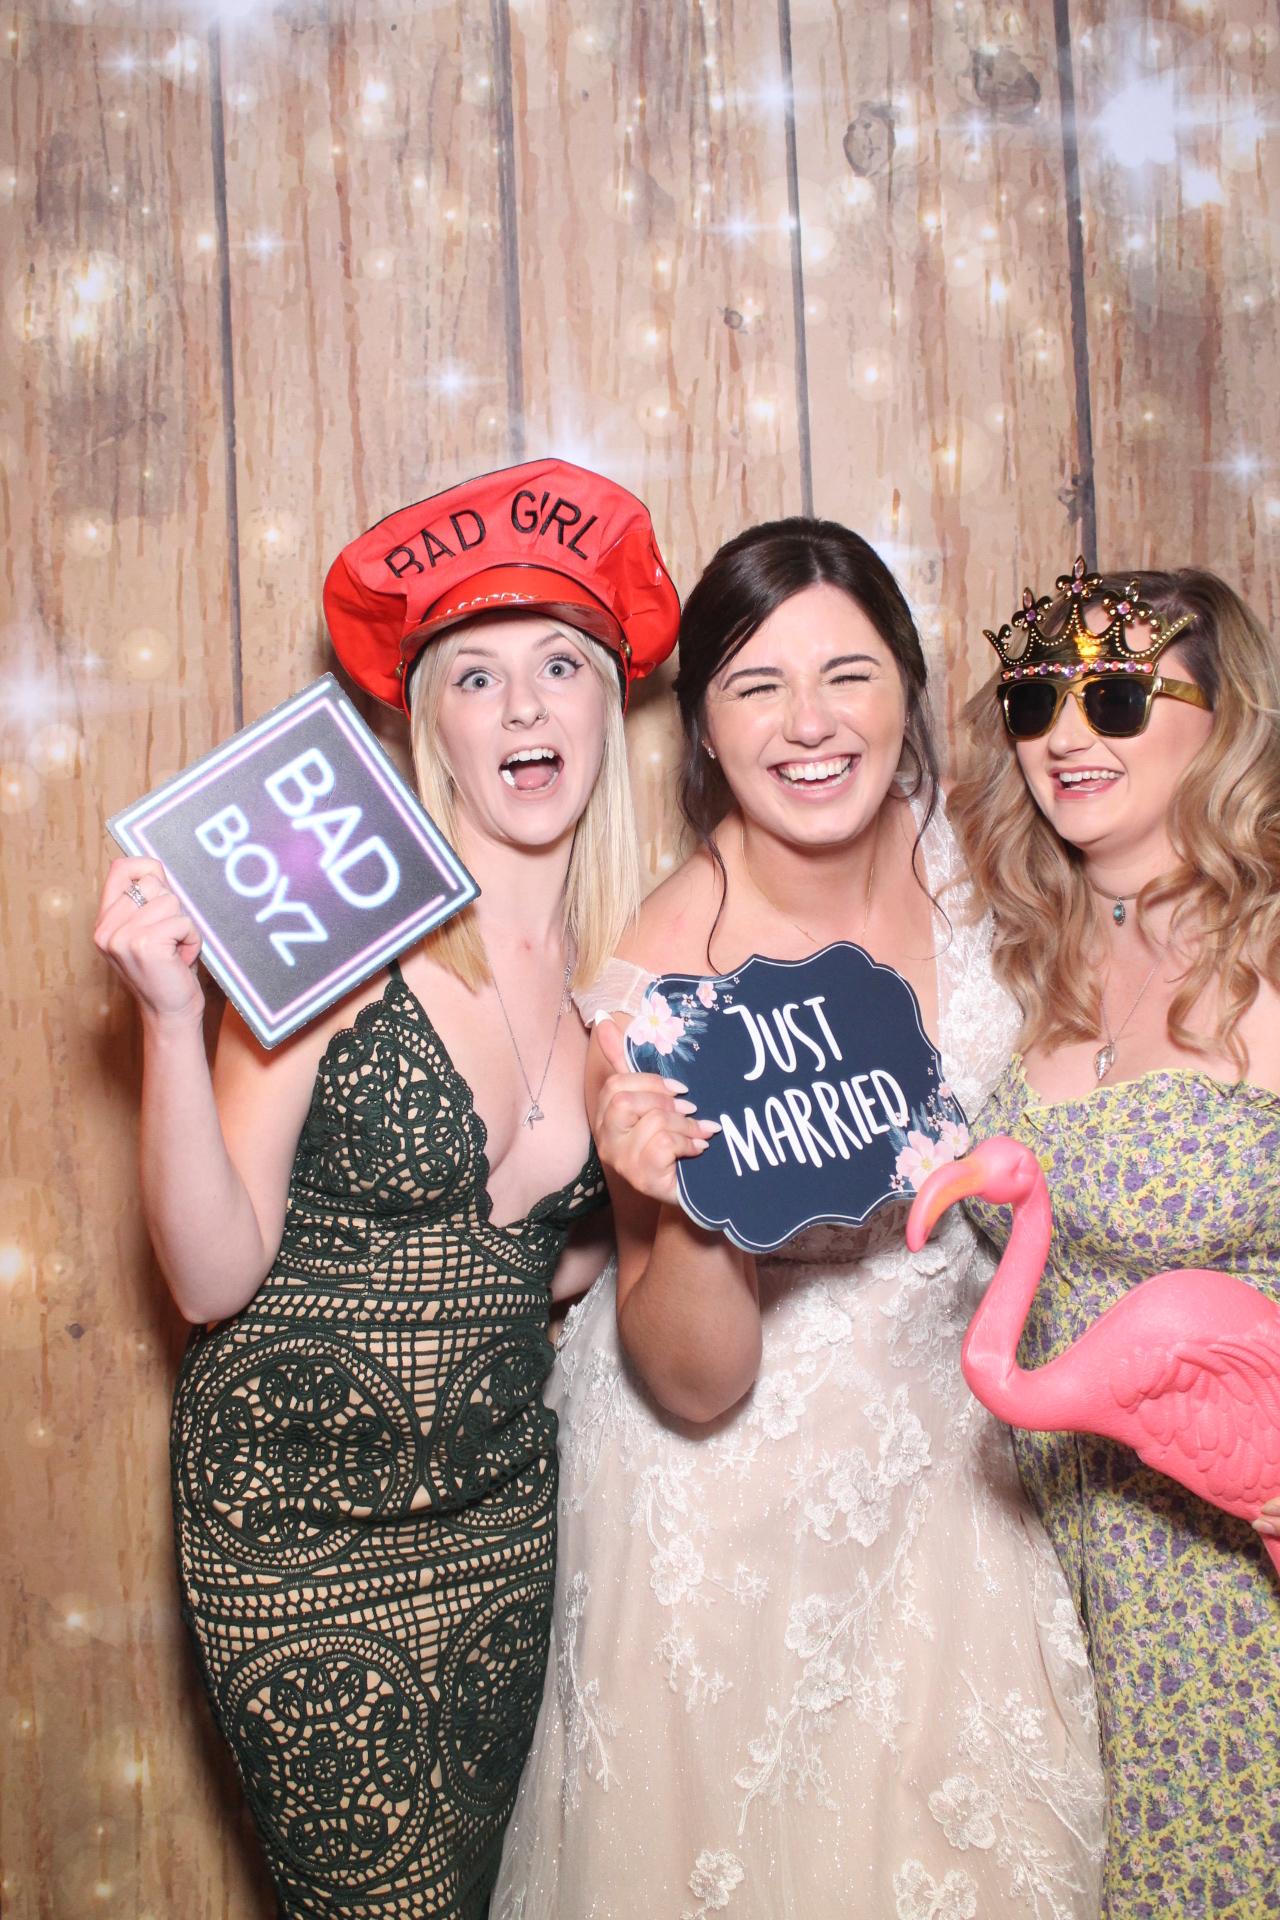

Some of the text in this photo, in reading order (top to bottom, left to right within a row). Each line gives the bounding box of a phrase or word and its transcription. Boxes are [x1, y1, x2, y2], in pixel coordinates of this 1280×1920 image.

[384, 490, 598, 579] BAD GIRL
[264, 747, 400, 909] BAD
[195, 804, 329, 967] BOYZ
[723, 996, 843, 1081] JUST
[719, 1069, 909, 1176] MARRIED
